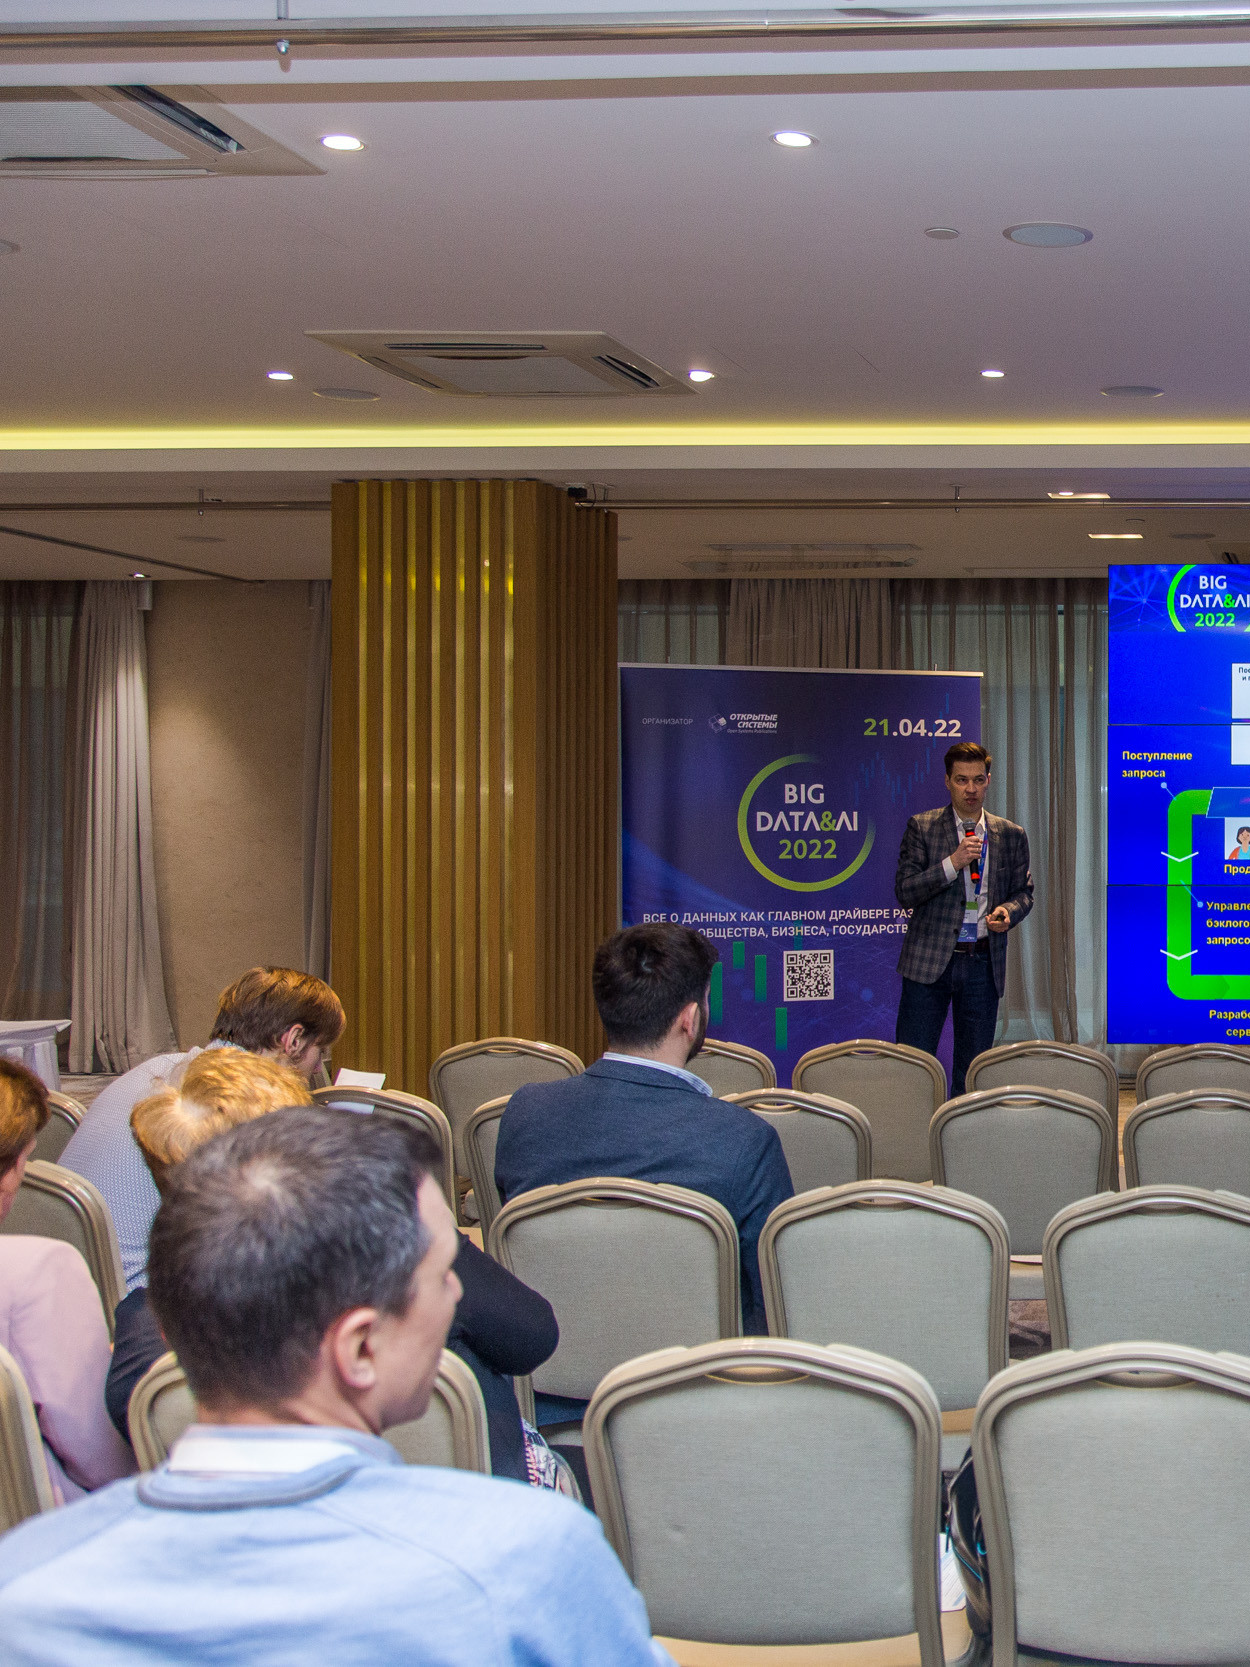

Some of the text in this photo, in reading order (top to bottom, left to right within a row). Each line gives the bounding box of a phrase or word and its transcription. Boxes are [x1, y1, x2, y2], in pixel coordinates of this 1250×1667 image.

[1199, 575, 1227, 590] BIG
[1180, 593, 1250, 608] DATA&AI
[1194, 612, 1236, 627] 2022
[642, 717, 694, 725] ОРГАНИЗАТОР
[729, 713, 778, 721] ОТКРЫТЫЕ
[737, 721, 778, 729] СИСТЕМЫ
[863, 718, 962, 738] 21.04.22
[1122, 751, 1193, 762] Поступление
[1122, 769, 1166, 780] запроса
[784, 783, 825, 804] BIG
[756, 811, 858, 832] DATA&AI
[778, 839, 837, 859] 2022
[643, 913, 667, 923] ВСЕ
[670, 913, 679, 923] О
[682, 912, 737, 925] ДАННЫХ
[740, 911, 766, 922] КАК
[768, 910, 826, 921] ГЛАВНОМ
[829, 907, 890, 921] ДРАЙВЕРЕ
[771, 925, 830, 938] БИЗНЕСА,
